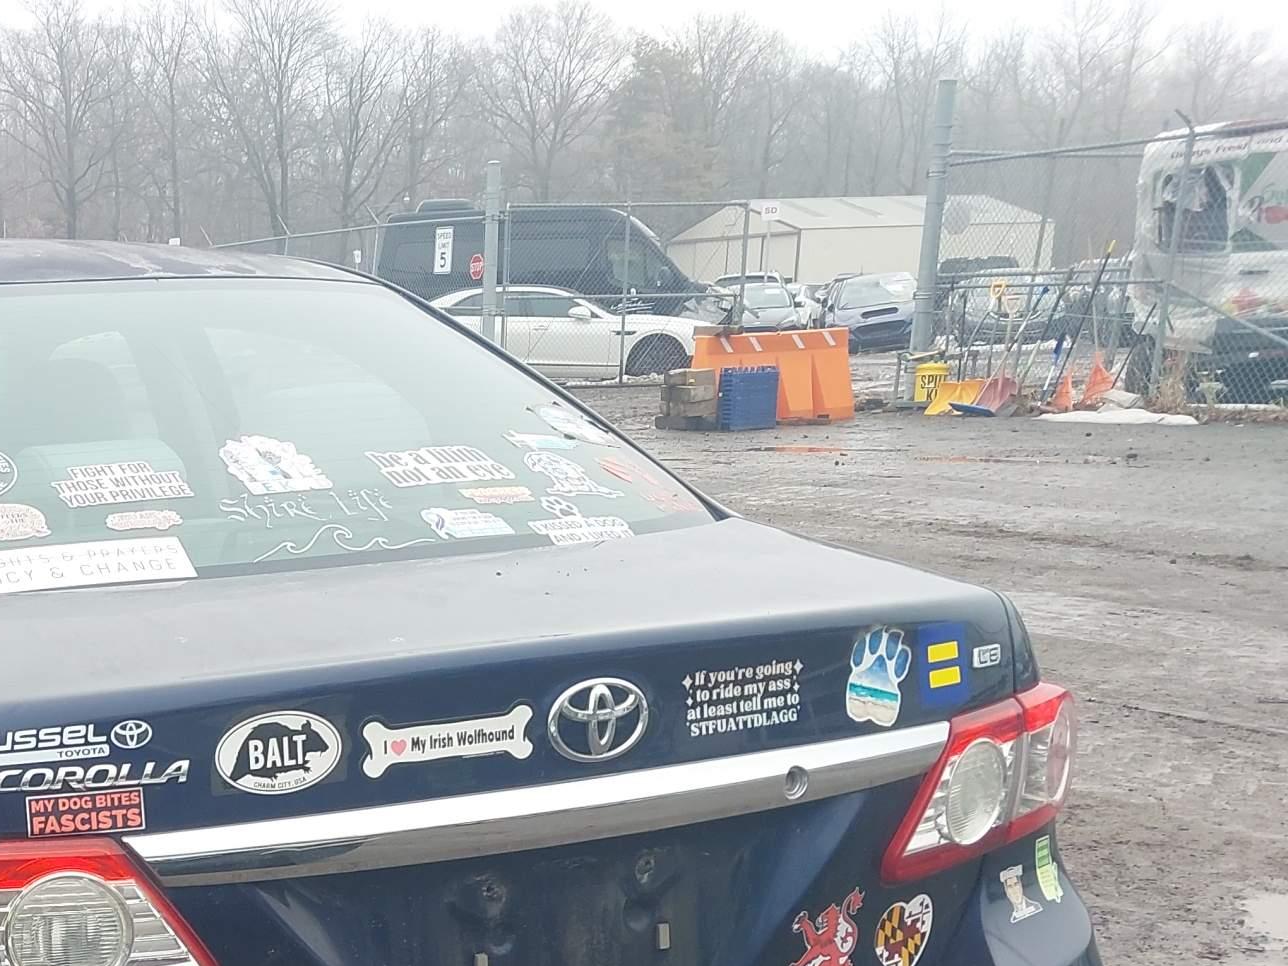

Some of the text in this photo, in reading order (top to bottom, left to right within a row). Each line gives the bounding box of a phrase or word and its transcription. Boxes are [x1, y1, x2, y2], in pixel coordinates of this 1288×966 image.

[440, 252, 446, 268] 5
[70, 462, 151, 480] FIGHT FOR
[56, 472, 182, 494] THOSE WITHOUT
[63, 484, 193, 506] YOUR PRIVILEGE
[88, 544, 179, 560] PRAYERS
[50, 566, 64, 579] &
[79, 558, 177, 577] CHANGE
[695, 660, 793, 687] If you're going
[696, 678, 791, 702] to ride my ass
[687, 693, 800, 720] at least tell me to
[384, 724, 515, 755] I My Irish Wolfhound
[56, 746, 106, 759] TOYOTA
[248, 734, 307, 770] BALT
[253, 780, 276, 789] CHARM
[295, 777, 307, 786] USA
[31, 791, 140, 814] MY DOG BITES
[33, 808, 142, 835] FASCISTS
